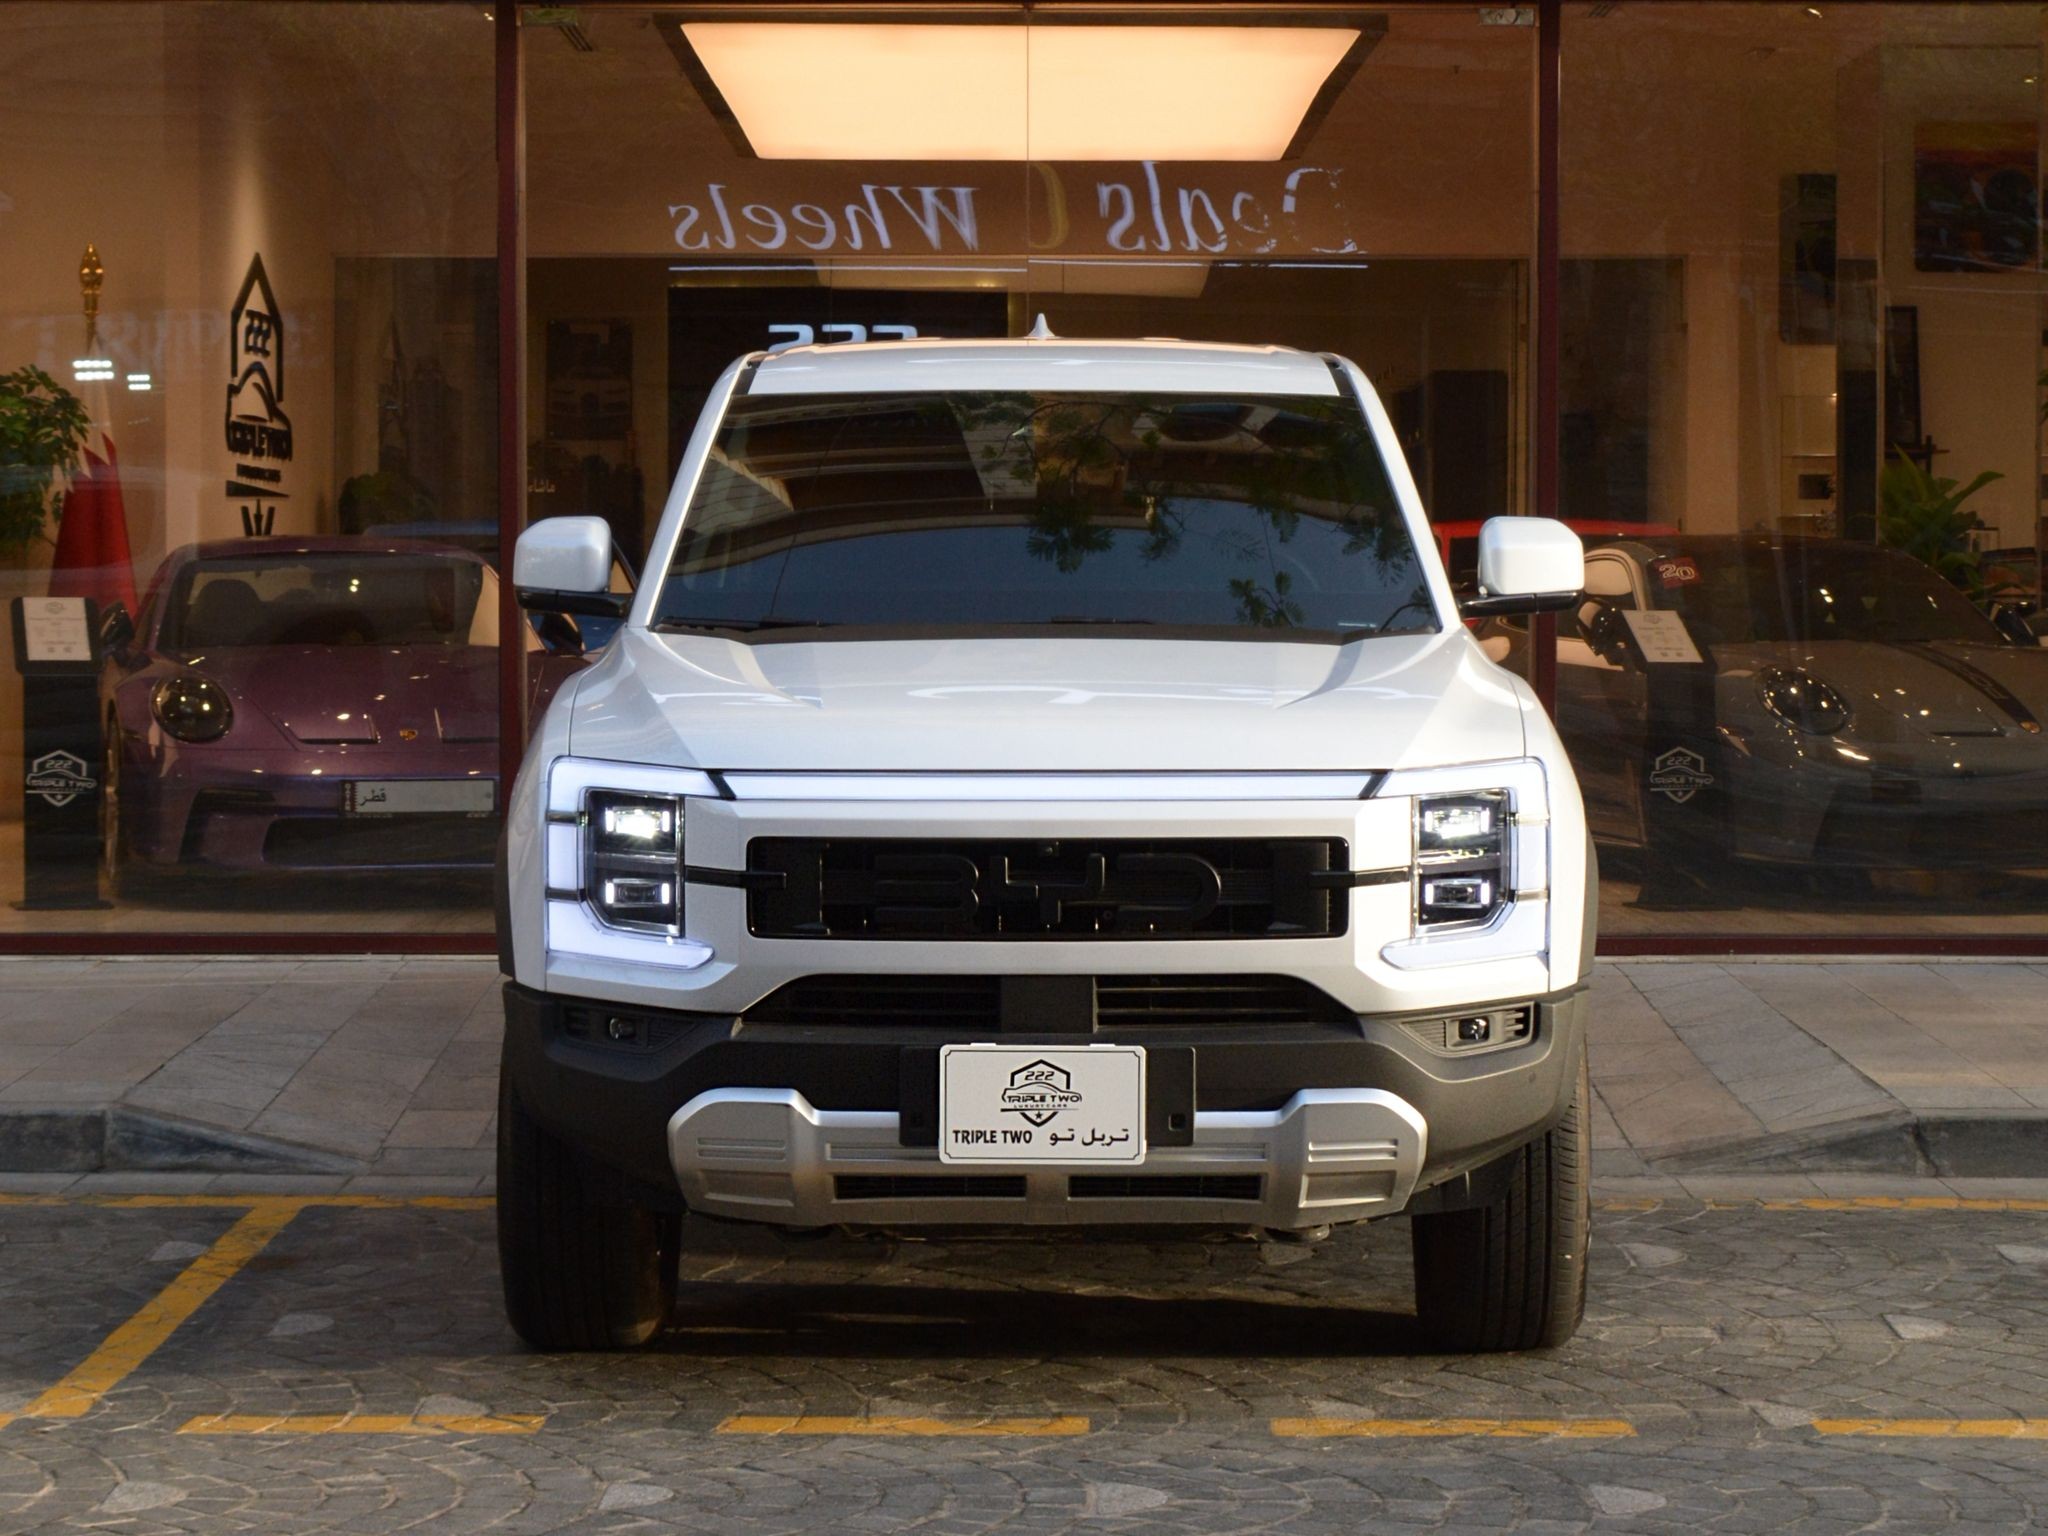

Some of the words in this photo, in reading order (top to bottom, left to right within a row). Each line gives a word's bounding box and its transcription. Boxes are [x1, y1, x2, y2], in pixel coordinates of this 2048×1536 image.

[45, 759, 73, 769] 222
[1666, 756, 1692, 766] 222
[359, 788, 386, 806] قطر
[1024, 1070, 1055, 1081] 222
[1006, 1095, 1047, 1103] TRIPLE
[1050, 1094, 1080, 1102] TWO
[952, 1129, 997, 1145] TRIPLE
[1001, 1129, 1033, 1144] TWO
[1049, 1128, 1075, 1147] تو
